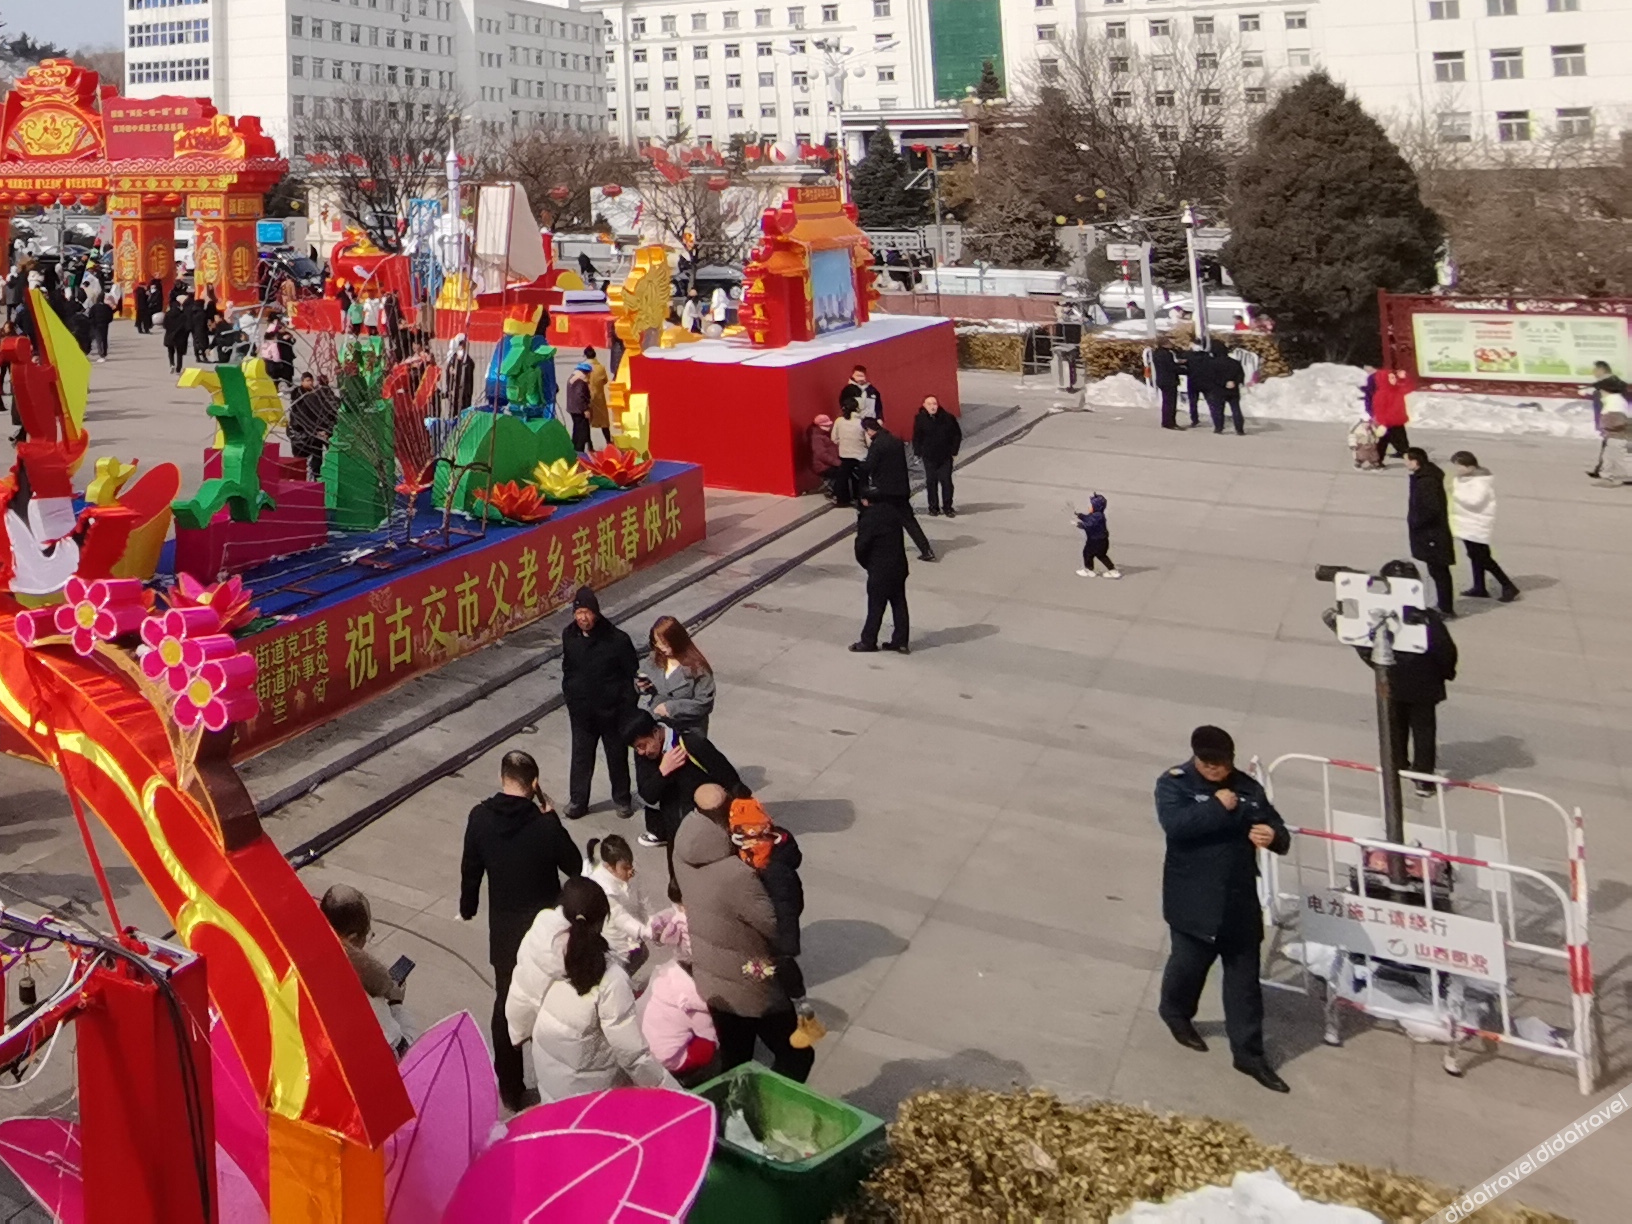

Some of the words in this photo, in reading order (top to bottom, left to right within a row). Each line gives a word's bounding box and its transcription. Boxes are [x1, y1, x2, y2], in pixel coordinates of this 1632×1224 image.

[345, 487, 683, 691] 祝古交市父老乡亲新春快乐
[1307, 894, 1449, 937] 电力施工请绕行
